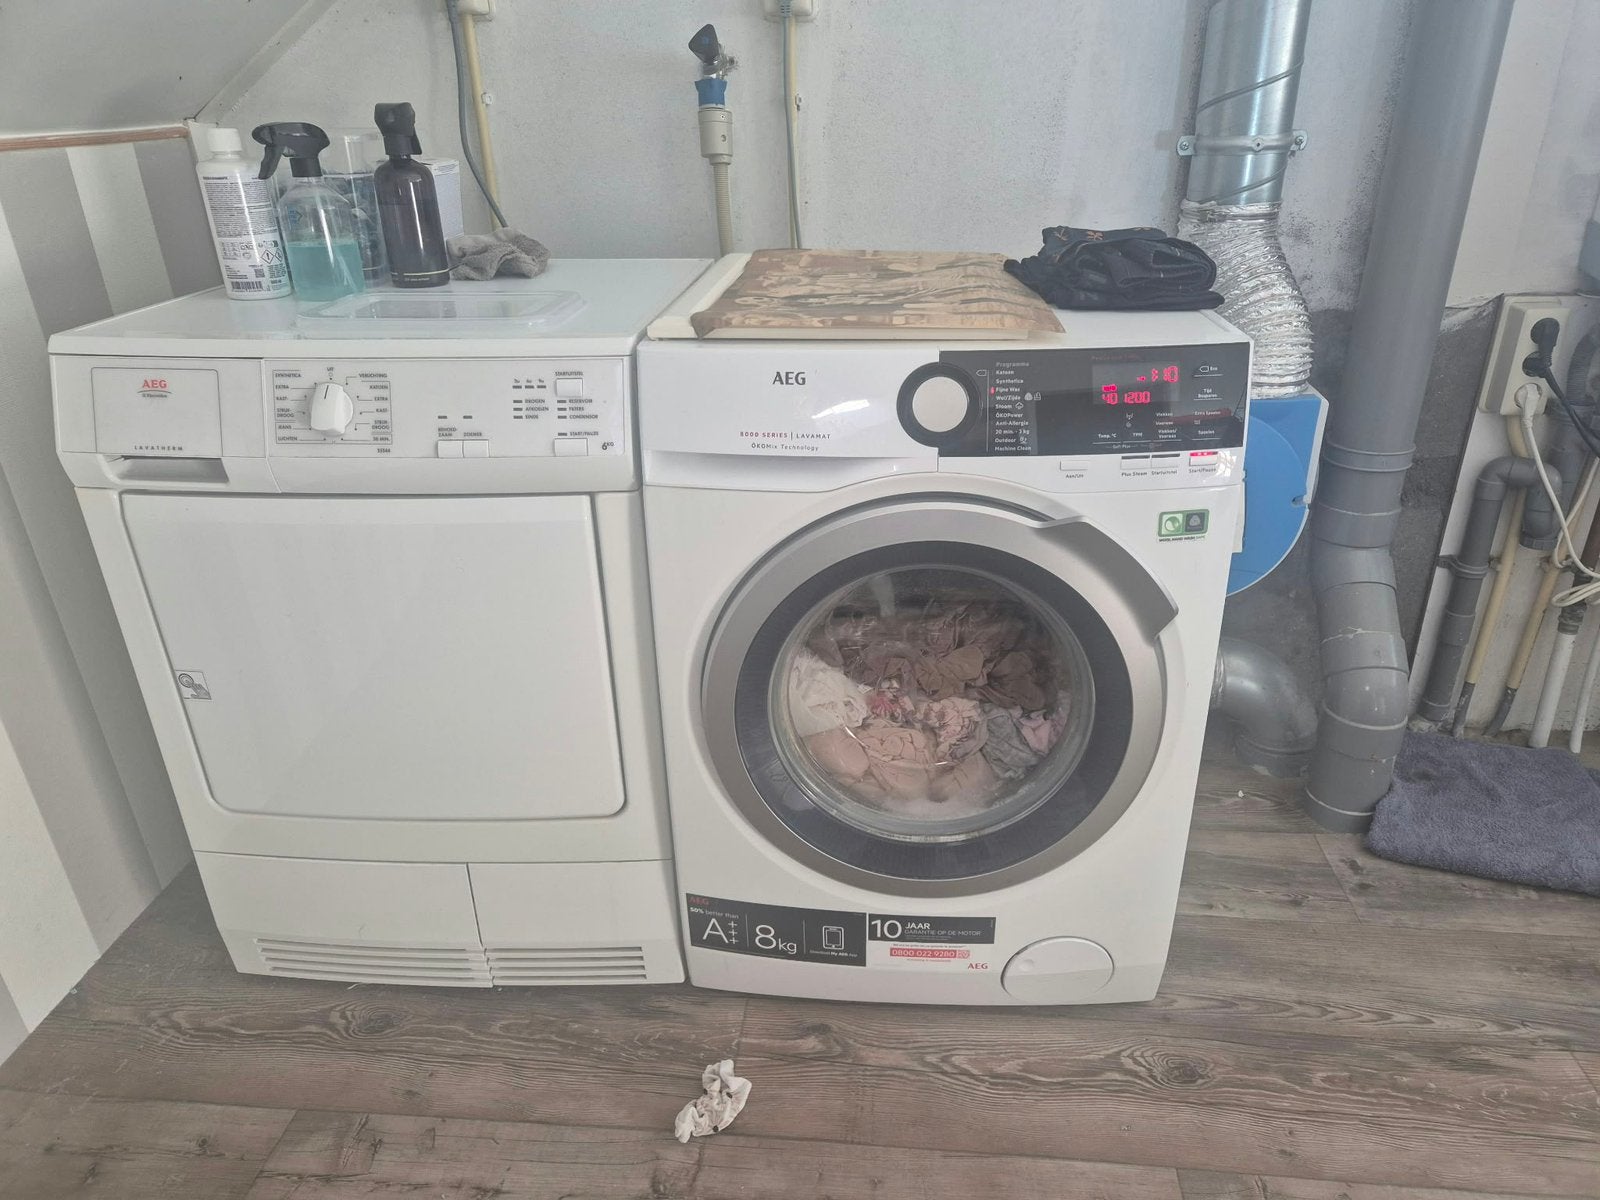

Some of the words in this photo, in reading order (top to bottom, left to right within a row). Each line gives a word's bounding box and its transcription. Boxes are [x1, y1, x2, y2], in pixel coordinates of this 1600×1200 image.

[142, 379, 167, 389] AEG
[772, 371, 806, 385] AEG
[1124, 391, 1150, 404] 1200
[689, 896, 709, 905] AEG
[690, 906, 704, 914] 50%
[725, 911, 739, 919] than
[871, 919, 902, 938] 10
[905, 922, 931, 930] JAAR
